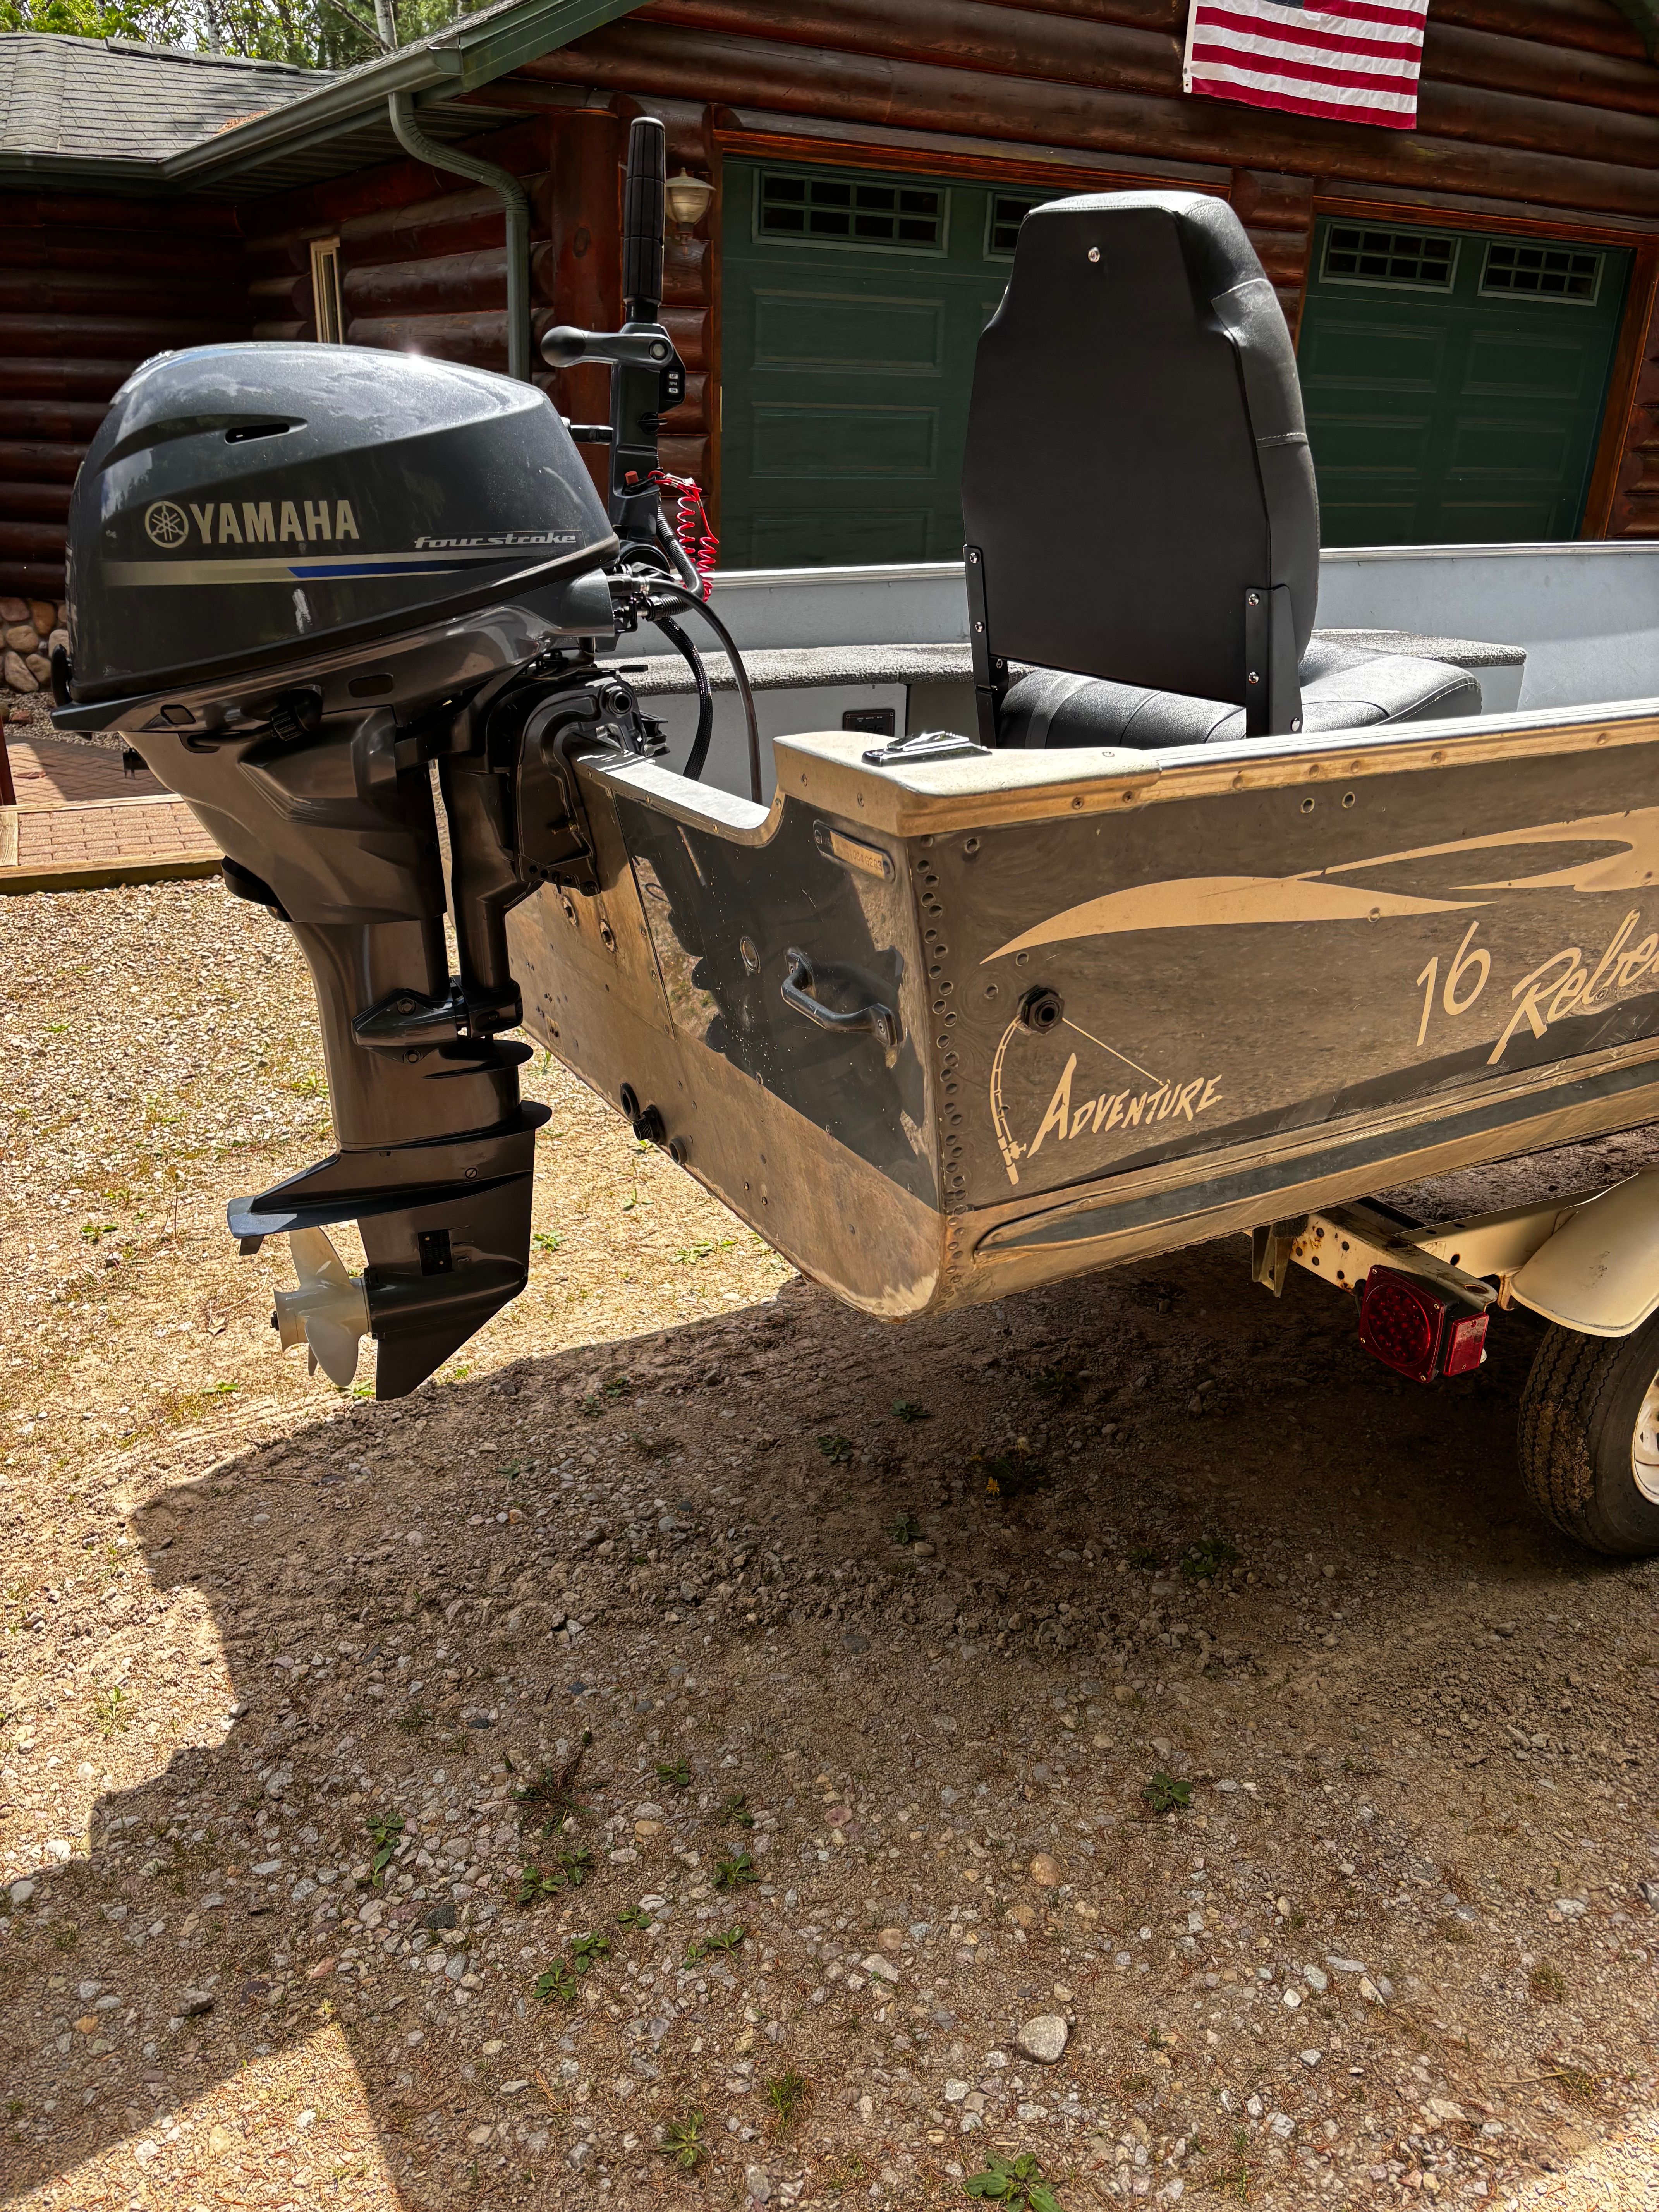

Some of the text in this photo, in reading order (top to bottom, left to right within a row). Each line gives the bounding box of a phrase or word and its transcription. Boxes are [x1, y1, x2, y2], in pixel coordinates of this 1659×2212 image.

[189, 500, 359, 544] YAMAHA
[1416, 908, 1659, 1065] 16 Rebe
[1027, 1053, 1223, 1158] ADVENTURE
